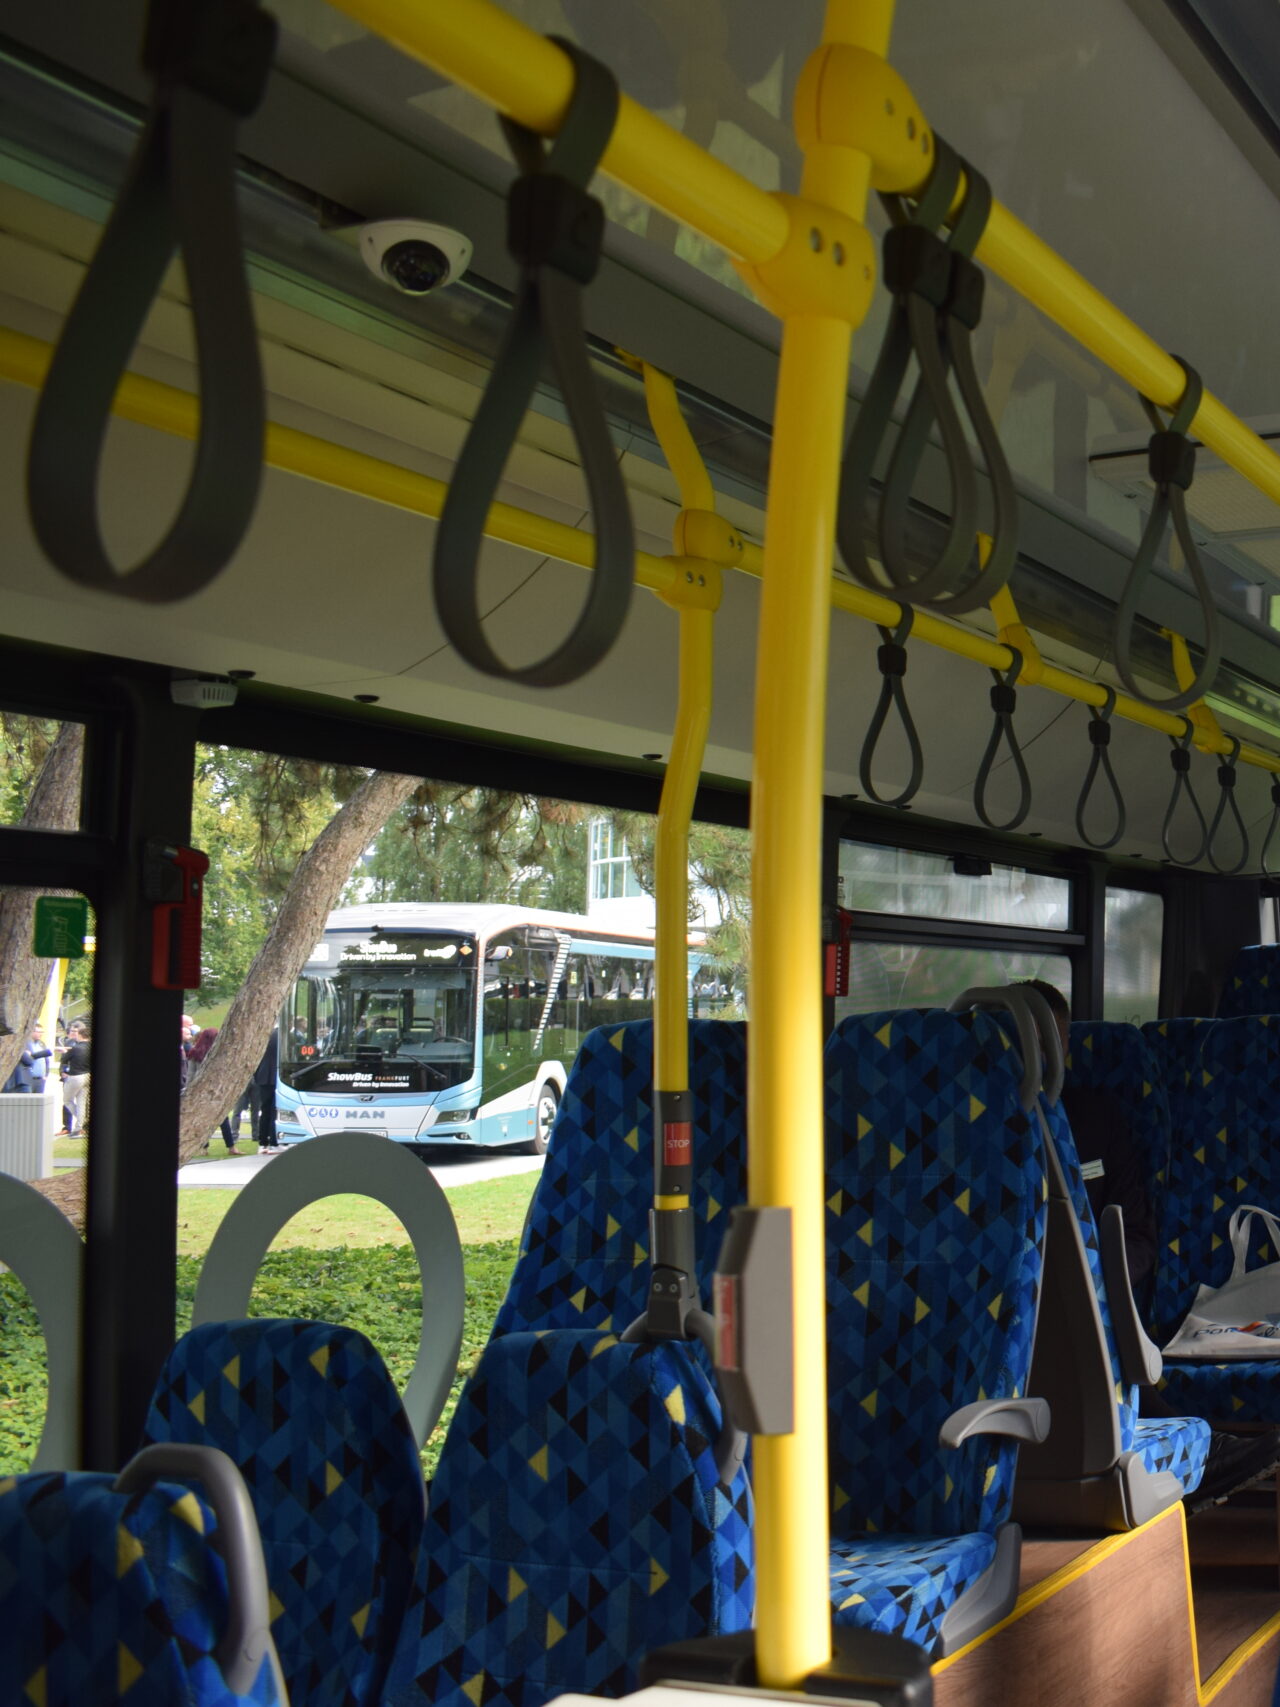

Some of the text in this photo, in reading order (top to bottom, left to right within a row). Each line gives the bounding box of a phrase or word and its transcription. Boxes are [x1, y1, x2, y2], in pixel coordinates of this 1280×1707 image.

[327, 1072, 373, 1081] ShowBus
[345, 1110, 385, 1119] MAN
[667, 1139, 690, 1149] STOP
